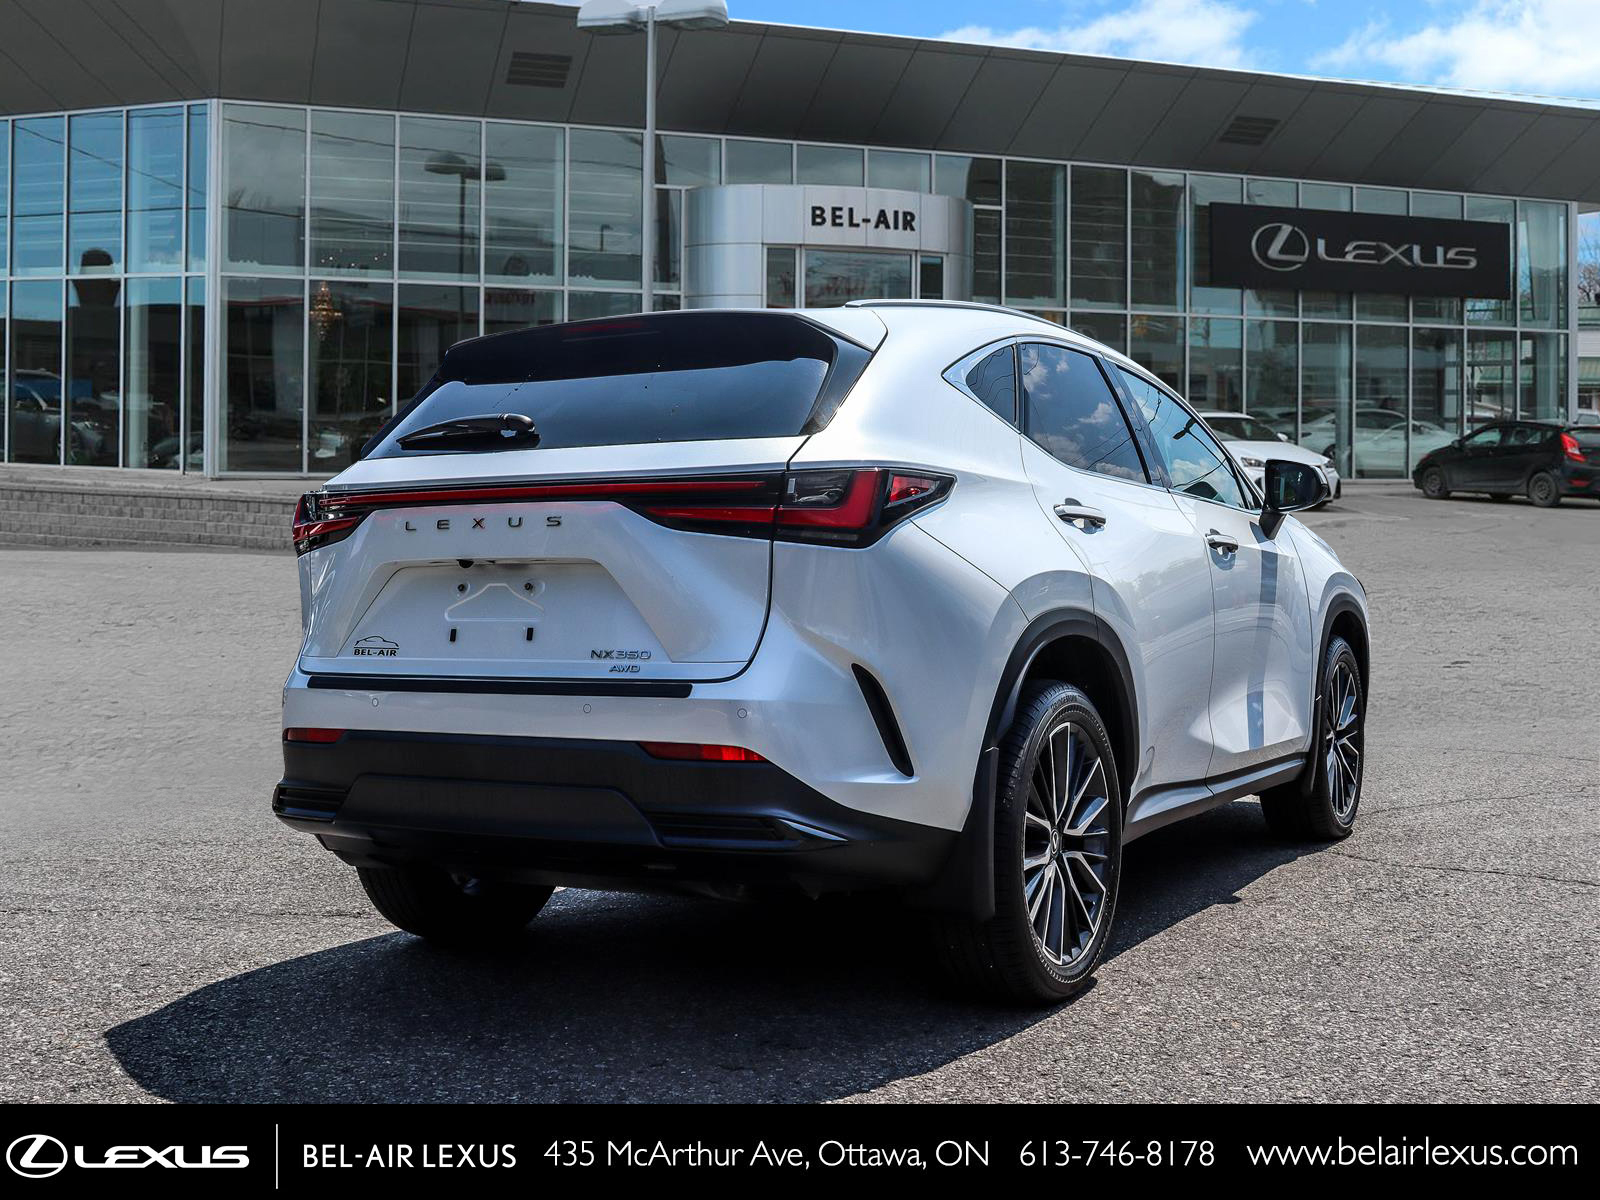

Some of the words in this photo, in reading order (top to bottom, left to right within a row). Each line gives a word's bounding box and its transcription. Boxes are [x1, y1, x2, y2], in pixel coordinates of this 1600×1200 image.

[811, 206, 916, 231] BEL-AIR
[1317, 238, 1478, 269] LEXUS
[405, 516, 562, 531] LEXUS
[353, 648, 397, 657] BEL-AIR
[590, 649, 652, 660] NX350
[608, 664, 641, 673] AWD
